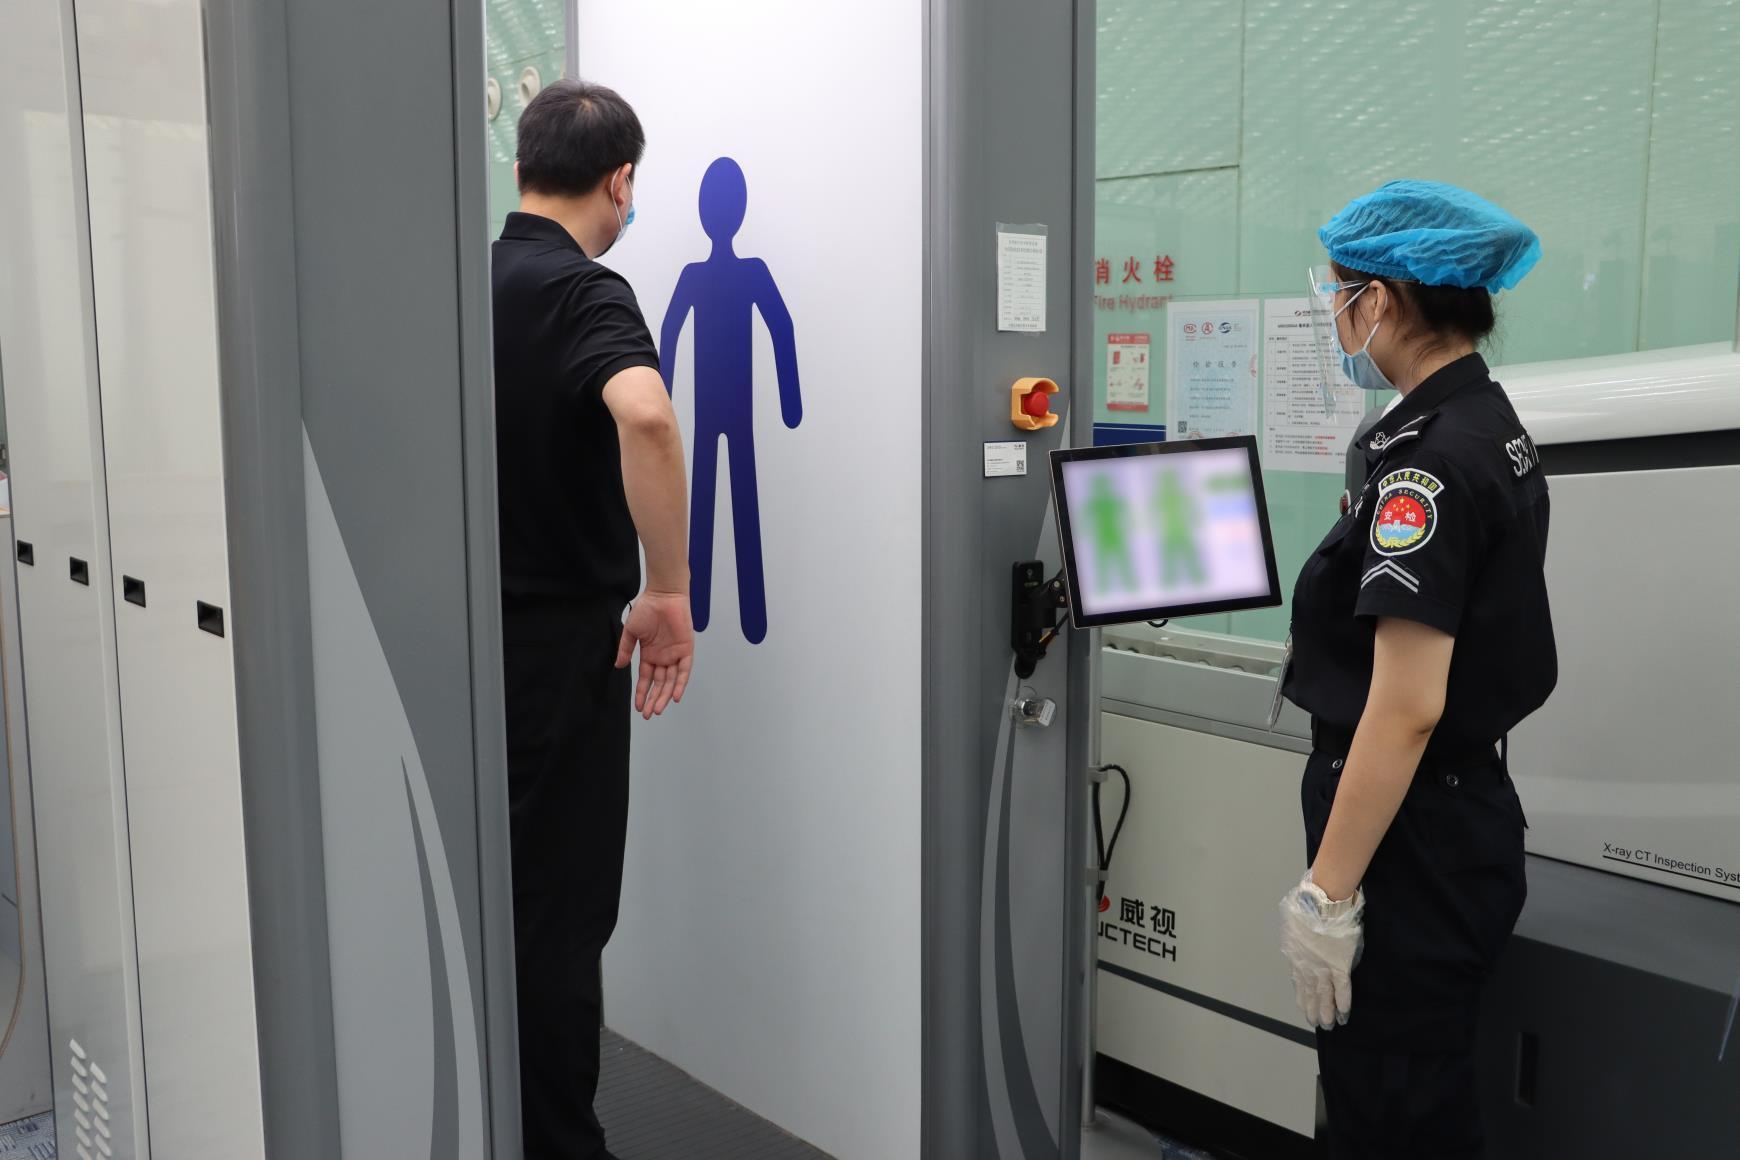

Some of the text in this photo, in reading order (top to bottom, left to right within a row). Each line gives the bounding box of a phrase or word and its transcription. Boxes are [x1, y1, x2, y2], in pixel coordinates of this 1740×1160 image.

[1382, 471, 1438, 492] 中华人民共和国
[1376, 489, 1433, 520] CHINA SECURITY
[1384, 511, 1417, 523] 安检
[1603, 842, 1740, 883] X-ray CT Inspection Syst
[1119, 897, 1177, 939] 威视
